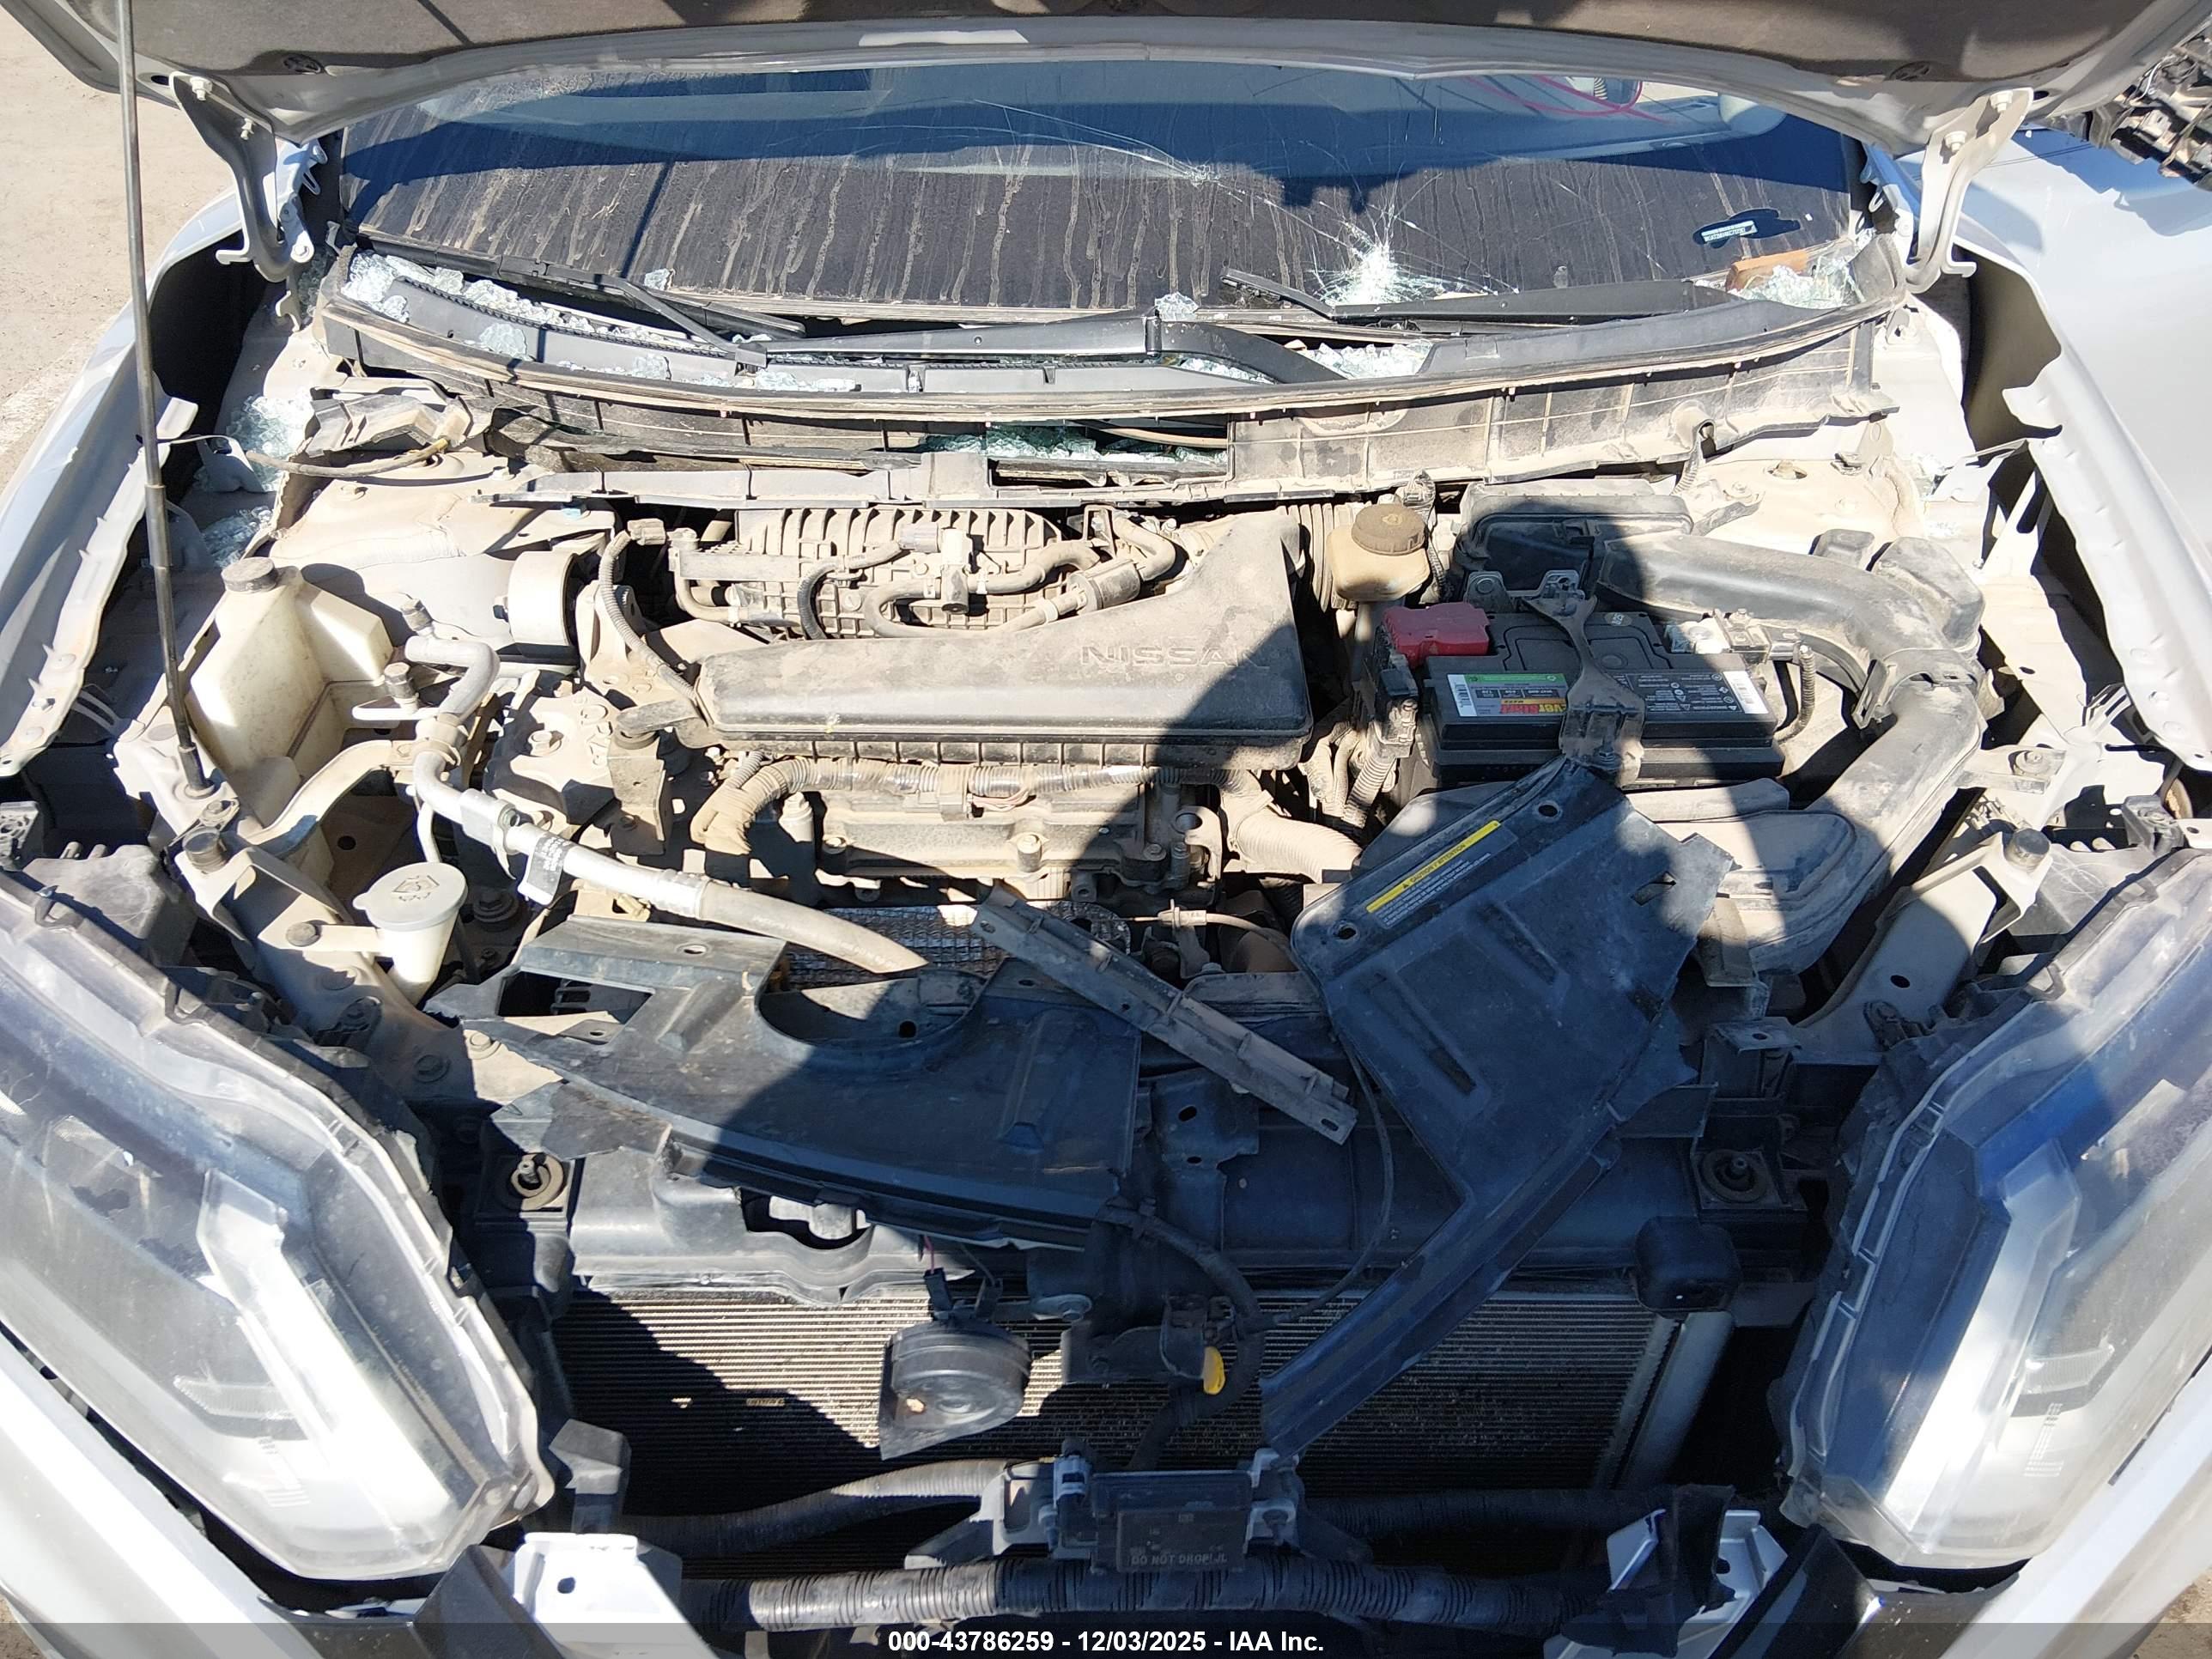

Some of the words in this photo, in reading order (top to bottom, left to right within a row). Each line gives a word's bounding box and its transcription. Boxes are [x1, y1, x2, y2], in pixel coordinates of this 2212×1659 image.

[1080, 646, 1269, 668] NISSAN
[1409, 863, 1434, 883] CAUTION
[1437, 843, 1466, 865] ATTENTION
[1131, 1555, 1148, 1565] DO
[1152, 1554, 1176, 1565] NOT
